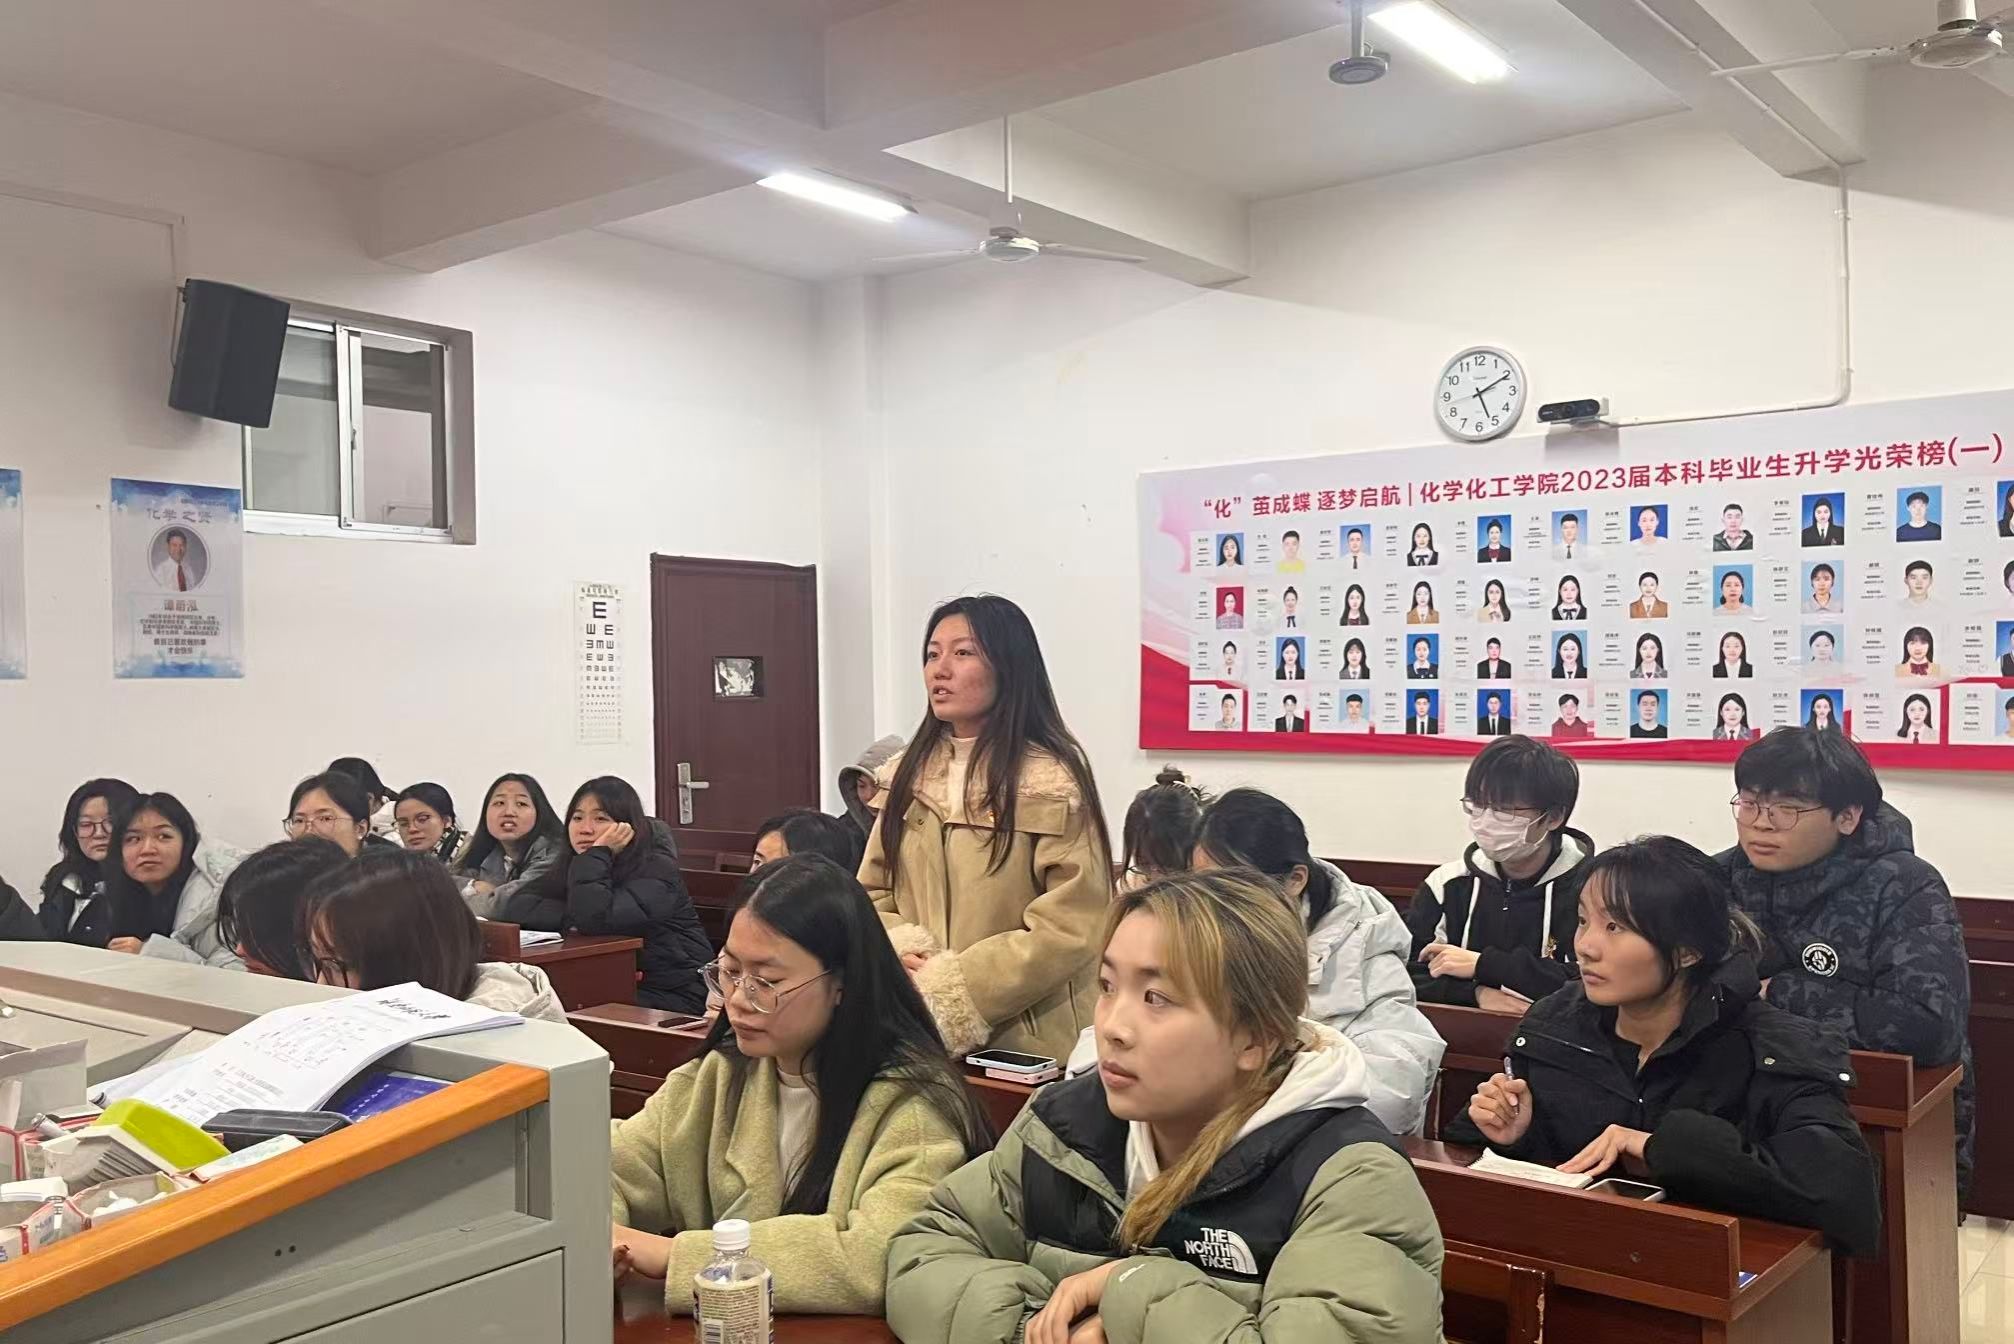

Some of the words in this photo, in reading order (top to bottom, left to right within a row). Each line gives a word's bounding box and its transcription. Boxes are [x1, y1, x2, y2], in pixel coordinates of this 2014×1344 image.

[1474, 355, 1486, 366] 12
[1494, 359, 1498, 369] 1
[1460, 362, 1470, 373] 11
[1448, 375, 1460, 386] 10
[1502, 369, 1511, 381] 2
[1509, 385, 1517, 396] 3
[1443, 391, 1451, 402] 9
[1449, 406, 1458, 418] 8
[1502, 402, 1510, 413] 4
[1460, 418, 1468, 429] 7
[1491, 415, 1500, 427] 5
[1475, 421, 1484, 433] 6
[1200, 1227, 1228, 1243] THE
[1184, 1239, 1231, 1257] NORTH
[1199, 1254, 1234, 1270] FACE
